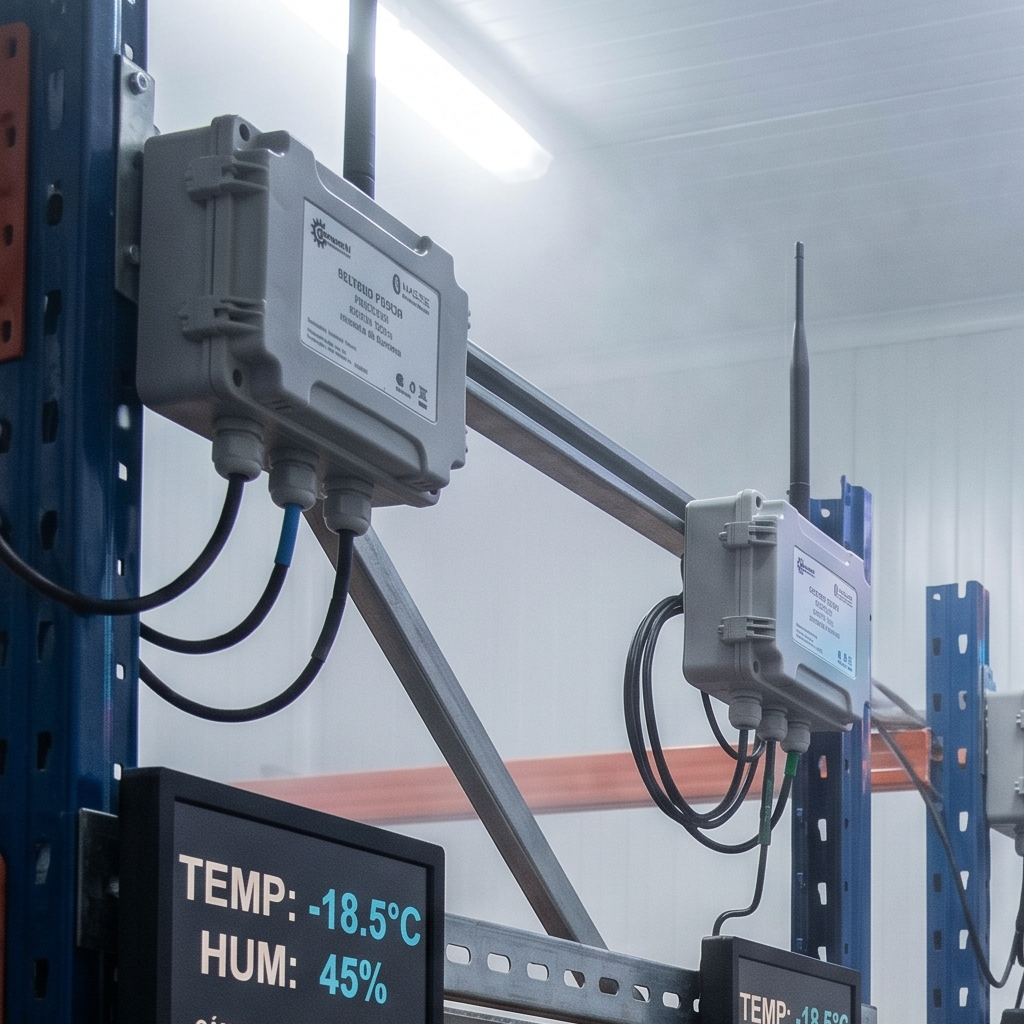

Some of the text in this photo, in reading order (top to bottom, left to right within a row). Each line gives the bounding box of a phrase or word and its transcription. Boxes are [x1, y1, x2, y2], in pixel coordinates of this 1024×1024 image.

[178, 854, 421, 947] TEMP: -18.5°C
[200, 929, 388, 1005] HUM: 45%
